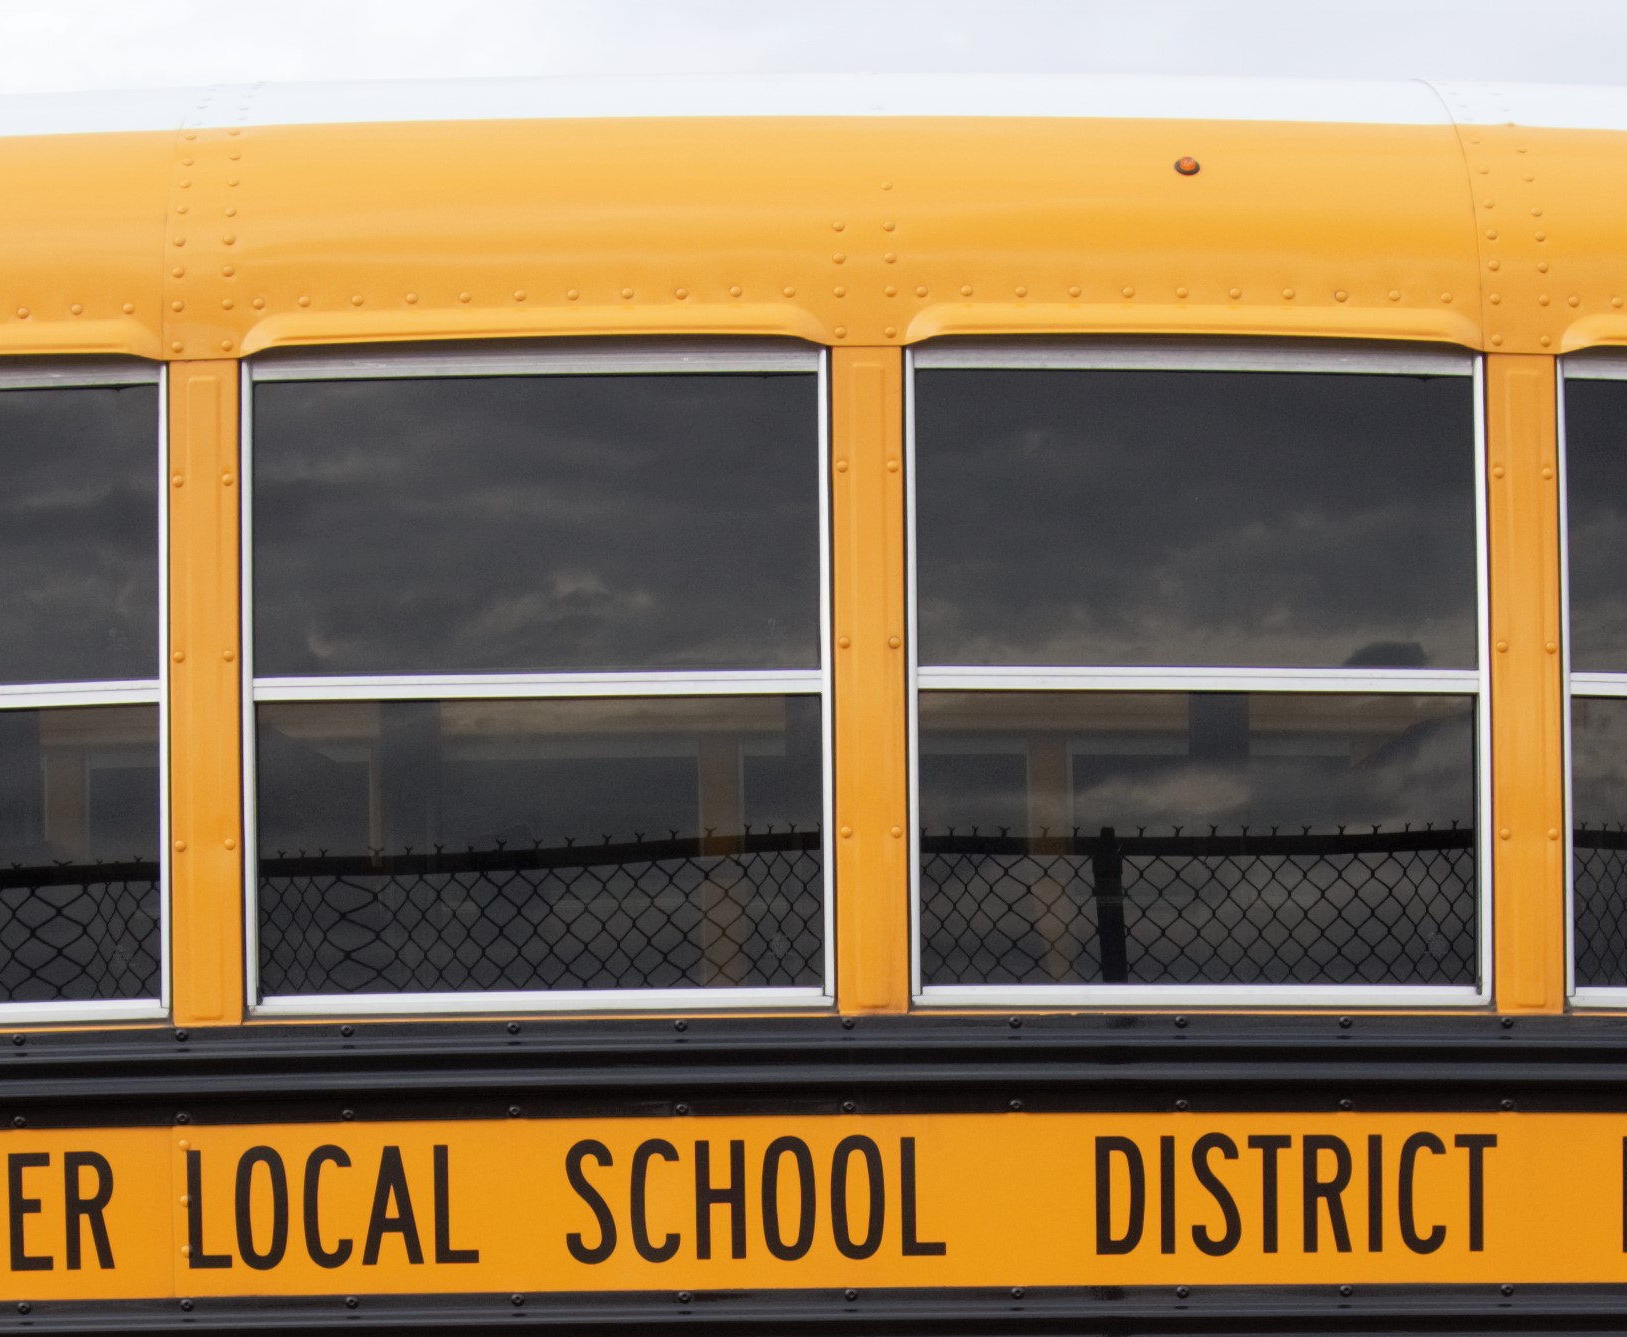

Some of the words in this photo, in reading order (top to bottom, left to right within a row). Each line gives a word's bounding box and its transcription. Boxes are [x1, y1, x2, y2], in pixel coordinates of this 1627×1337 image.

[185, 1143, 480, 1271] LOCAL
[564, 1133, 947, 1266] SCHOOL
[1094, 1130, 1499, 1258] DISTRICT
